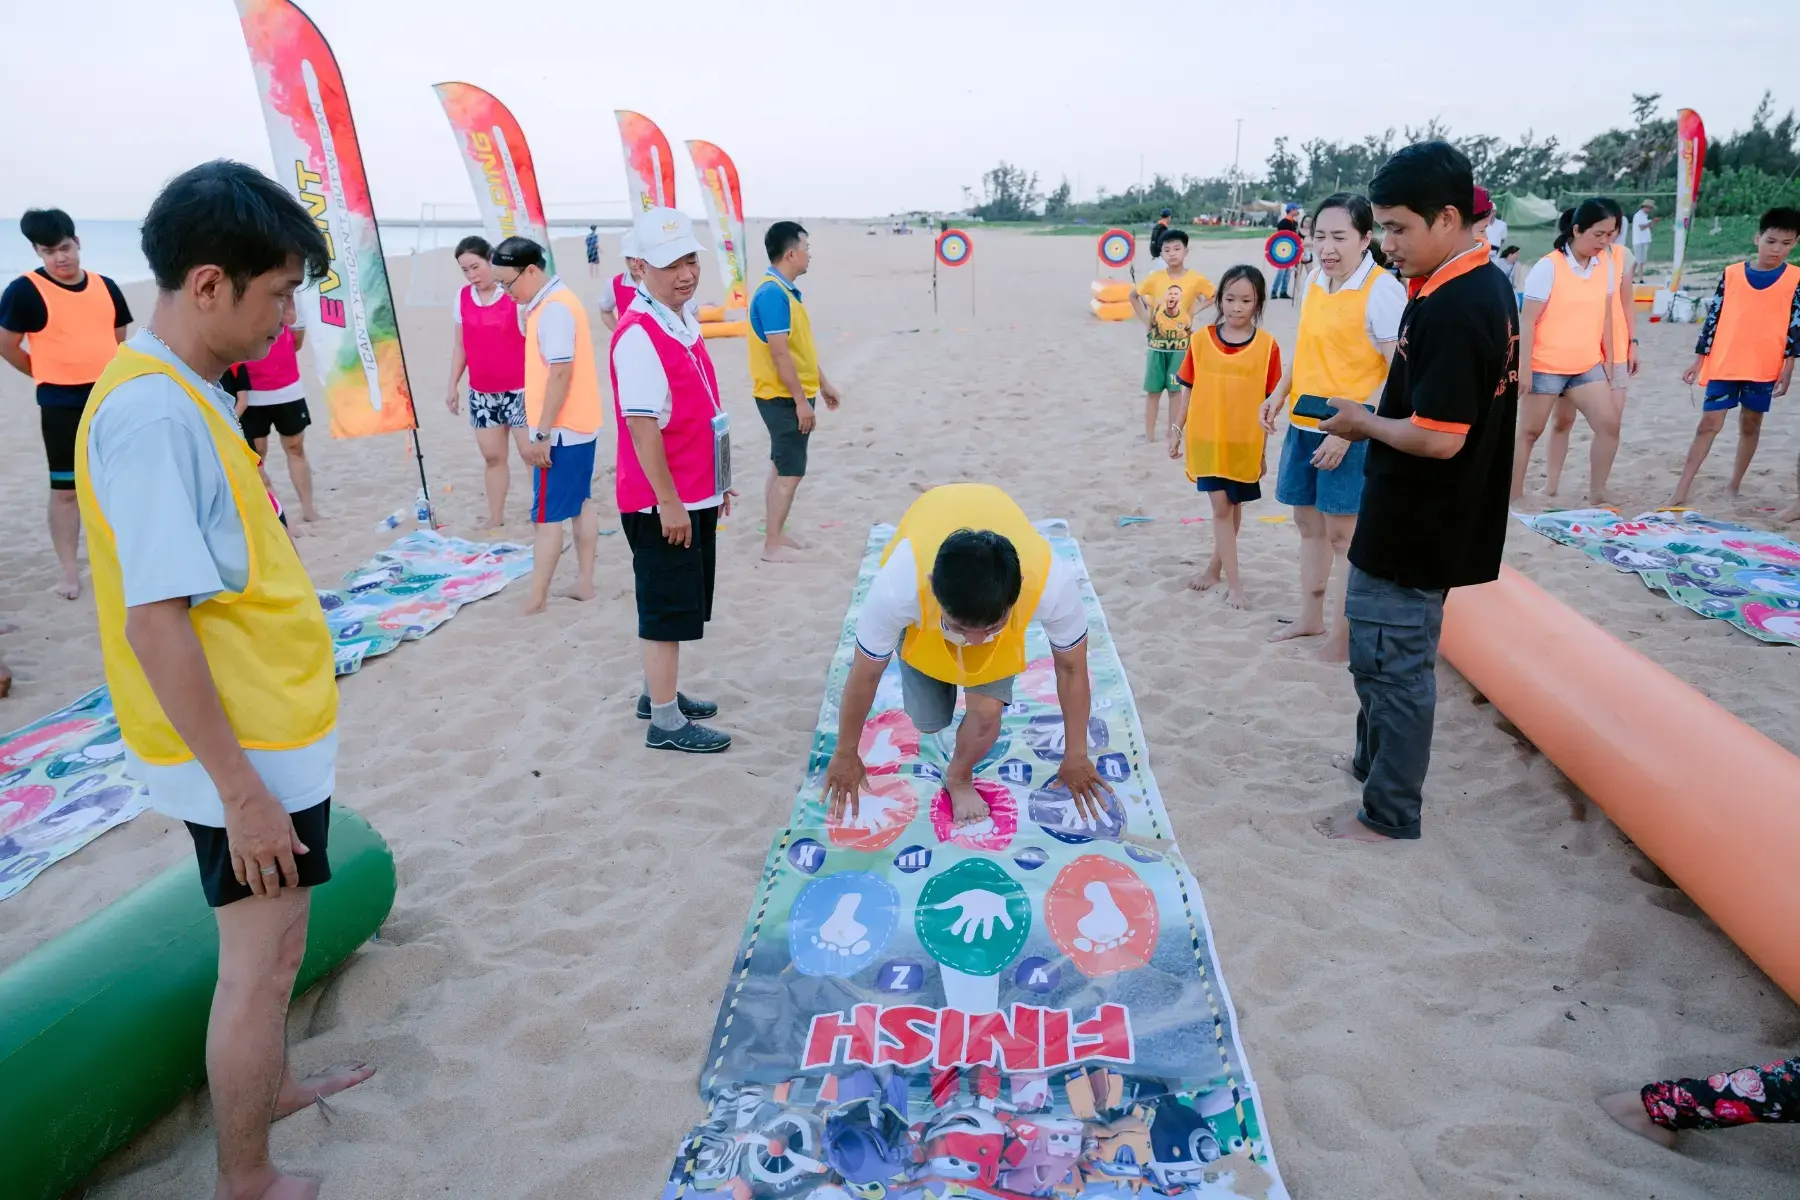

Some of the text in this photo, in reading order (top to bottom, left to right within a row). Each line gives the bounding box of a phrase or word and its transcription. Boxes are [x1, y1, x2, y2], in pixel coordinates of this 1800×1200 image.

[295, 159, 347, 329] EVNT
[1008, 763, 1023, 782] R
[1104, 757, 1122, 778] Q
[796, 845, 817, 867] X
[890, 965, 912, 990] Z
[800, 1002, 1136, 1071] FINISH
